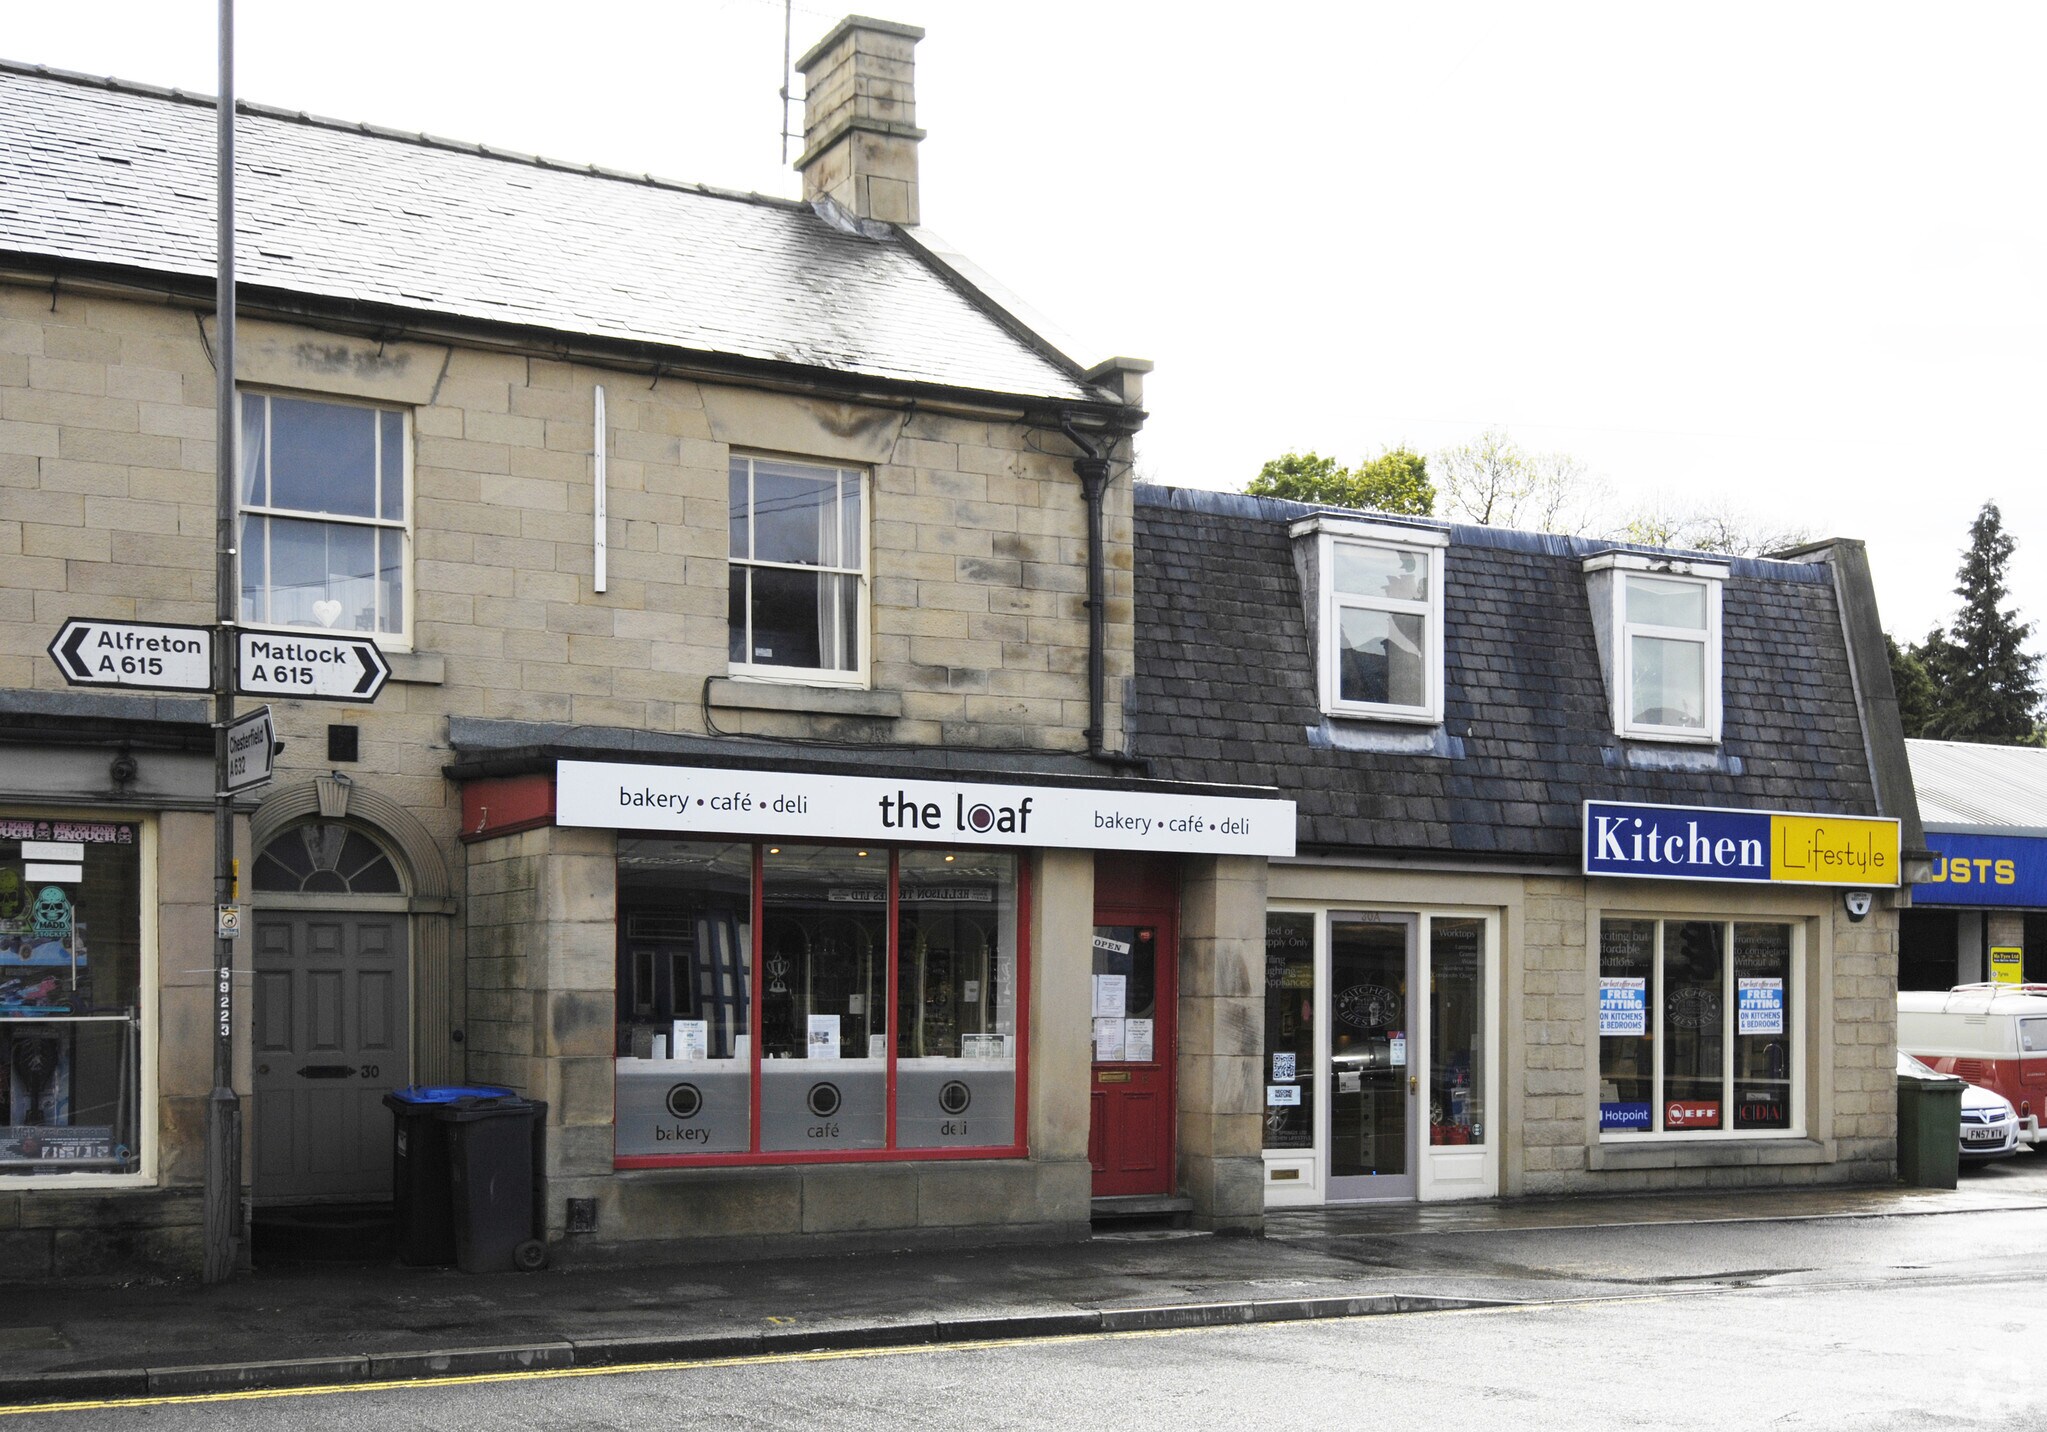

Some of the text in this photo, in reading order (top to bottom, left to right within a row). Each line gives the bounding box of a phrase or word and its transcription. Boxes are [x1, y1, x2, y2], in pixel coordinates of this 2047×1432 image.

[97, 631, 201, 654] Alfreton
[251, 641, 346, 664] Matlock
[98, 655, 163, 675] A 615
[252, 665, 313, 684] A 615
[229, 726, 263, 754] Chesterfield
[230, 757, 246, 777] A 632
[620, 786, 807, 814] bakery café deli
[879, 790, 1033, 833] the loaf
[1094, 810, 1250, 835] bakery café deli
[0, 828, 35, 840] UGH
[53, 830, 117, 843] ENOUGH
[1594, 816, 1884, 874] Kitchen Lifestyle
[1932, 857, 2015, 885] USTS
[40, 921, 66, 929] MADD
[1267, 926, 1294, 936] ted or
[34, 930, 72, 938] STOCKIST
[1440, 929, 1476, 940] Worktops
[1600, 930, 1648, 943] xciting but
[1094, 939, 1122, 952] OPEN
[1266, 937, 1309, 949] pply Only
[1735, 935, 1782, 947] From design
[1600, 943, 1640, 954] ffordable
[1734, 947, 1788, 958] to completion
[1600, 957, 1635, 967] olutions
[1735, 955, 1782, 968] Without any
[1735, 968, 1751, 977] fuss
[1341, 986, 1395, 1002] KITCHEN
[1607, 990, 1635, 999] FREE
[1670, 990, 1715, 1003] KITCHEN
[1747, 990, 1773, 999] FREE
[220, 967, 230, 1036] 59223
[1600, 1000, 1642, 1009] FITTING
[1740, 999, 1780, 1009] FITTING
[1340, 1010, 1395, 1026] LIFESYLE
[1611, 1012, 1642, 1021] KITCHENS
[1751, 1012, 1781, 1020] KITCHENS
[1746, 1020, 1780, 1028] BEDROOMS
[361, 1065, 380, 1078] 30
[1605, 1109, 1648, 1123] Hotpoint
[1669, 1105, 1716, 1121] NEFF
[1741, 1104, 1779, 1121] CDA
[656, 1125, 711, 1144] bakery
[807, 1122, 840, 1138] café
[941, 1121, 967, 1136] dei
[1970, 1129, 1990, 1139] FN57
